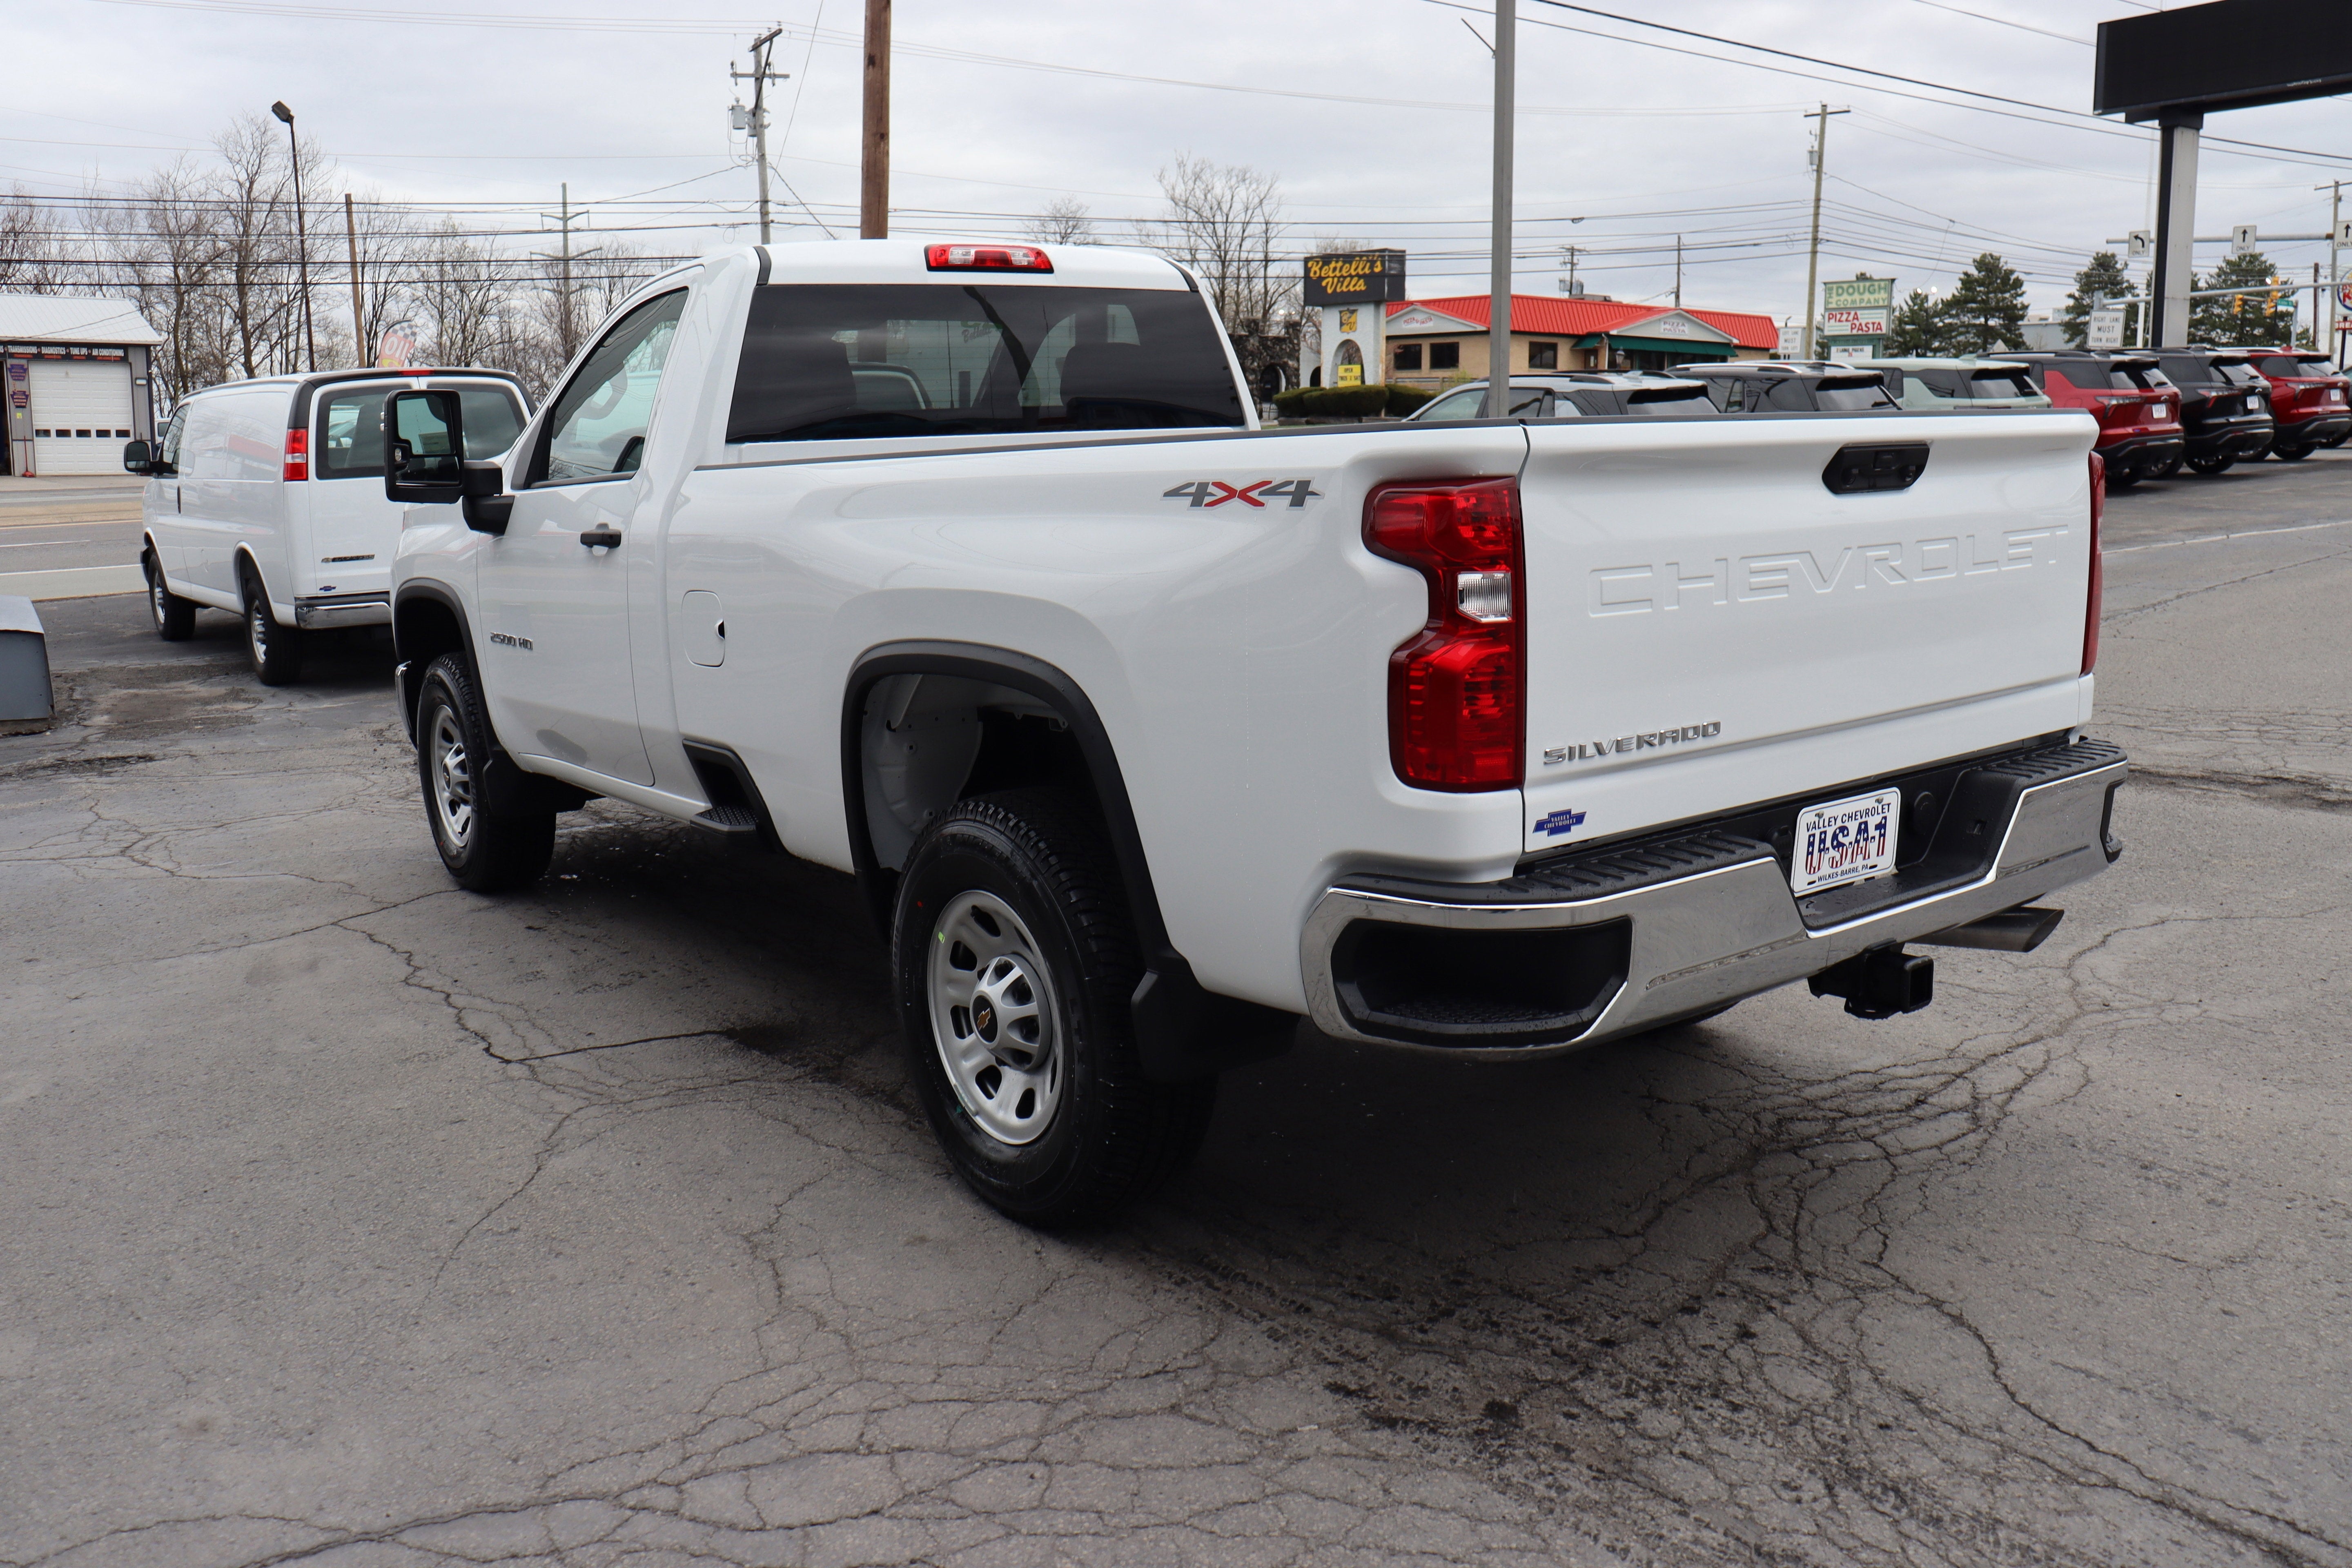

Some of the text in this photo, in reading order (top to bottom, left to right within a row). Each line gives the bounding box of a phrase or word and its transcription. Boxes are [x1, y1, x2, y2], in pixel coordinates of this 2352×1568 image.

[1307, 252, 1383, 279] Bettelli's
[1322, 277, 1367, 294] Villa
[1836, 283, 1888, 296] DOUGH
[1836, 298, 1887, 307] COMPANY
[1420, 317, 1432, 325] PASTA
[1828, 311, 1859, 323] PIZZA
[1850, 322, 1883, 333] PASTA
[8, 345, 38, 354] TRANSMISSIONS
[42, 346, 66, 354] DIAGNOSTICS
[1163, 480, 1321, 507] 4X4
[1588, 524, 2069, 617] CHEVROLET
[490, 632, 533, 650] 2500 HD
[1544, 720, 1721, 765] SILVERADO
[1544, 818, 1576, 829] CHEVROLET
[1806, 802, 1891, 833] VALLEY CHEVROLET
[1817, 866, 1860, 882] WILKES-BARRE,
